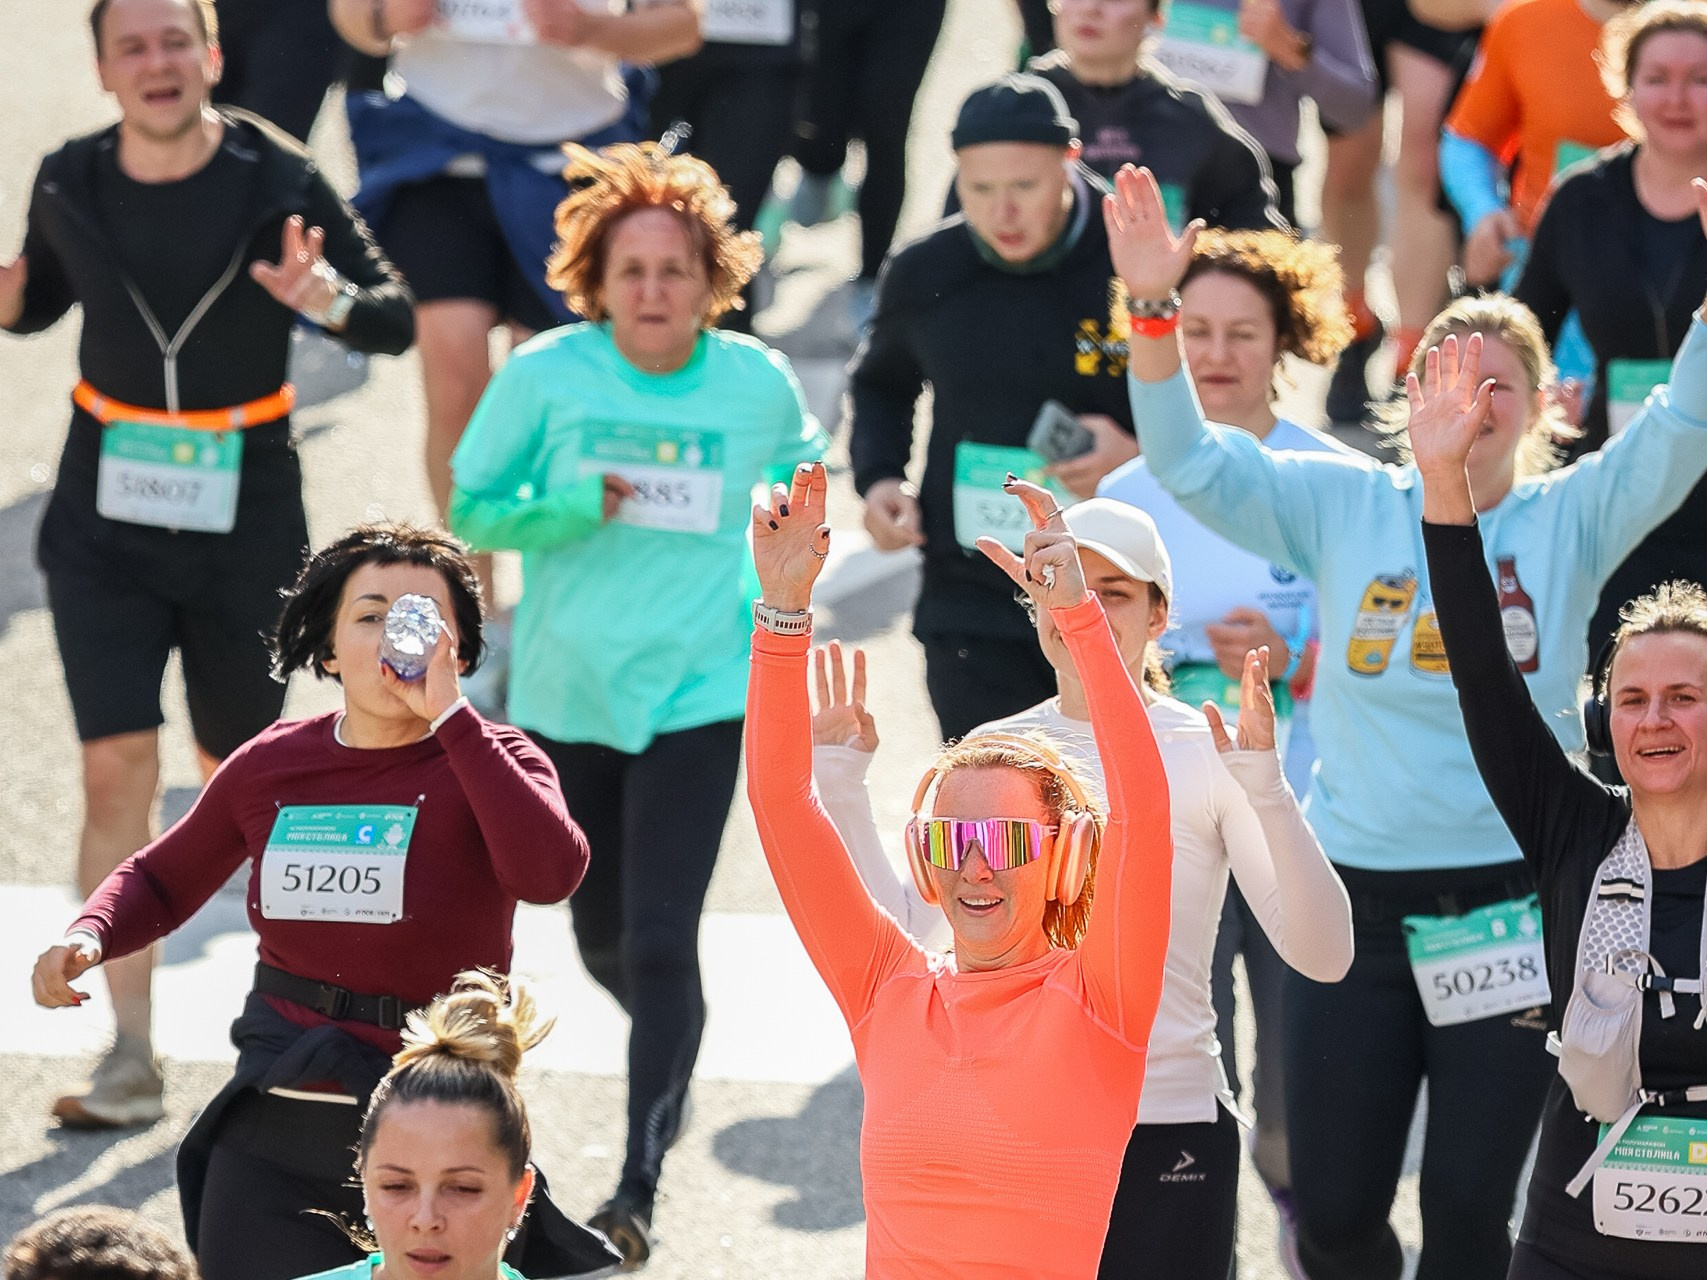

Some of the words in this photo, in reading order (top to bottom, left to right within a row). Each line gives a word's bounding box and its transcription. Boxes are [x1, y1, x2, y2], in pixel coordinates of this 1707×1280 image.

[357, 825, 373, 842] C
[281, 864, 381, 895] 51205
[1432, 956, 1539, 1001] 50238
[1159, 1173, 1206, 1182] DEMIX
[1613, 1182, 1707, 1217] 5262
